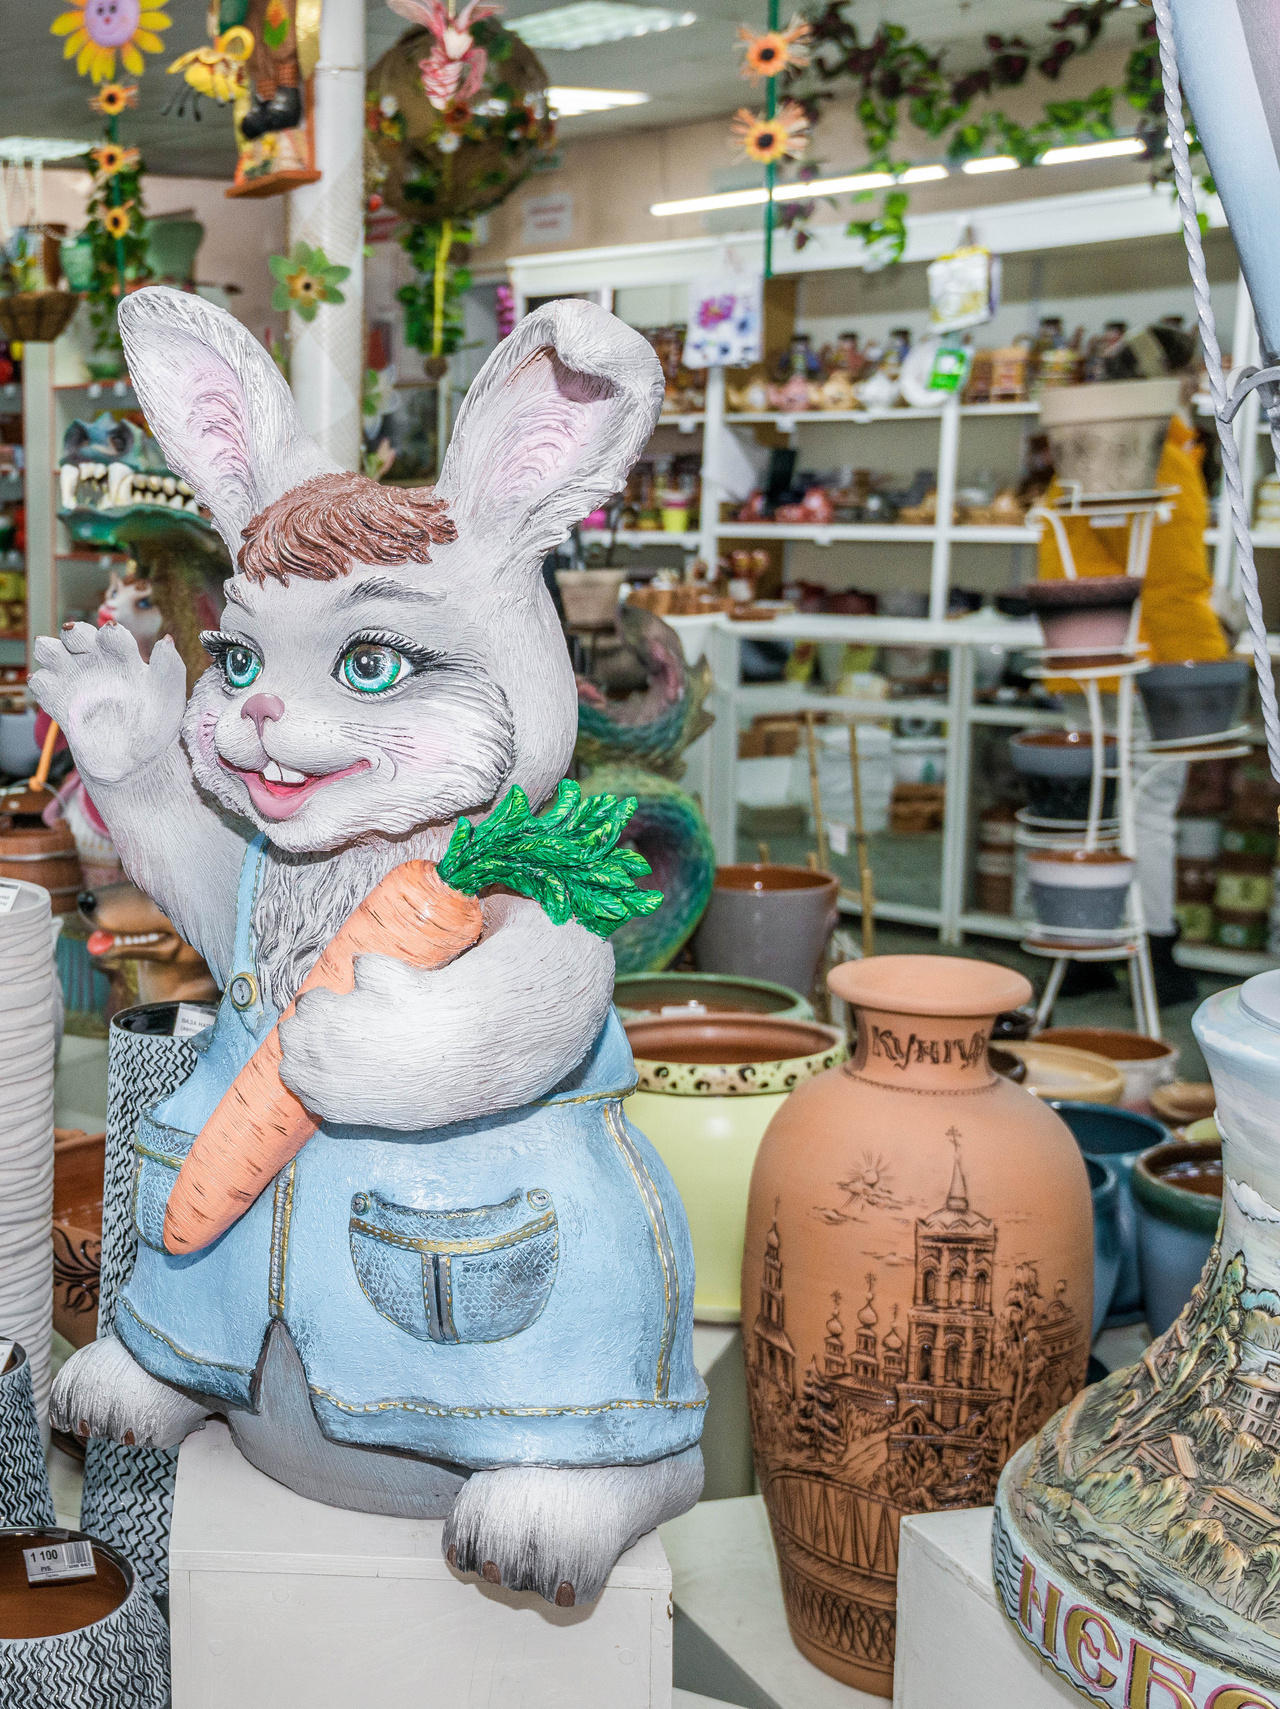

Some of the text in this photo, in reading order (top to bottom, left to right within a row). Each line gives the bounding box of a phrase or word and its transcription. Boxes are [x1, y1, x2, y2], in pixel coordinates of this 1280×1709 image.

[182, 1018, 197, 1026] ВАЗА
[30, 1549, 58, 1562] 1 100
